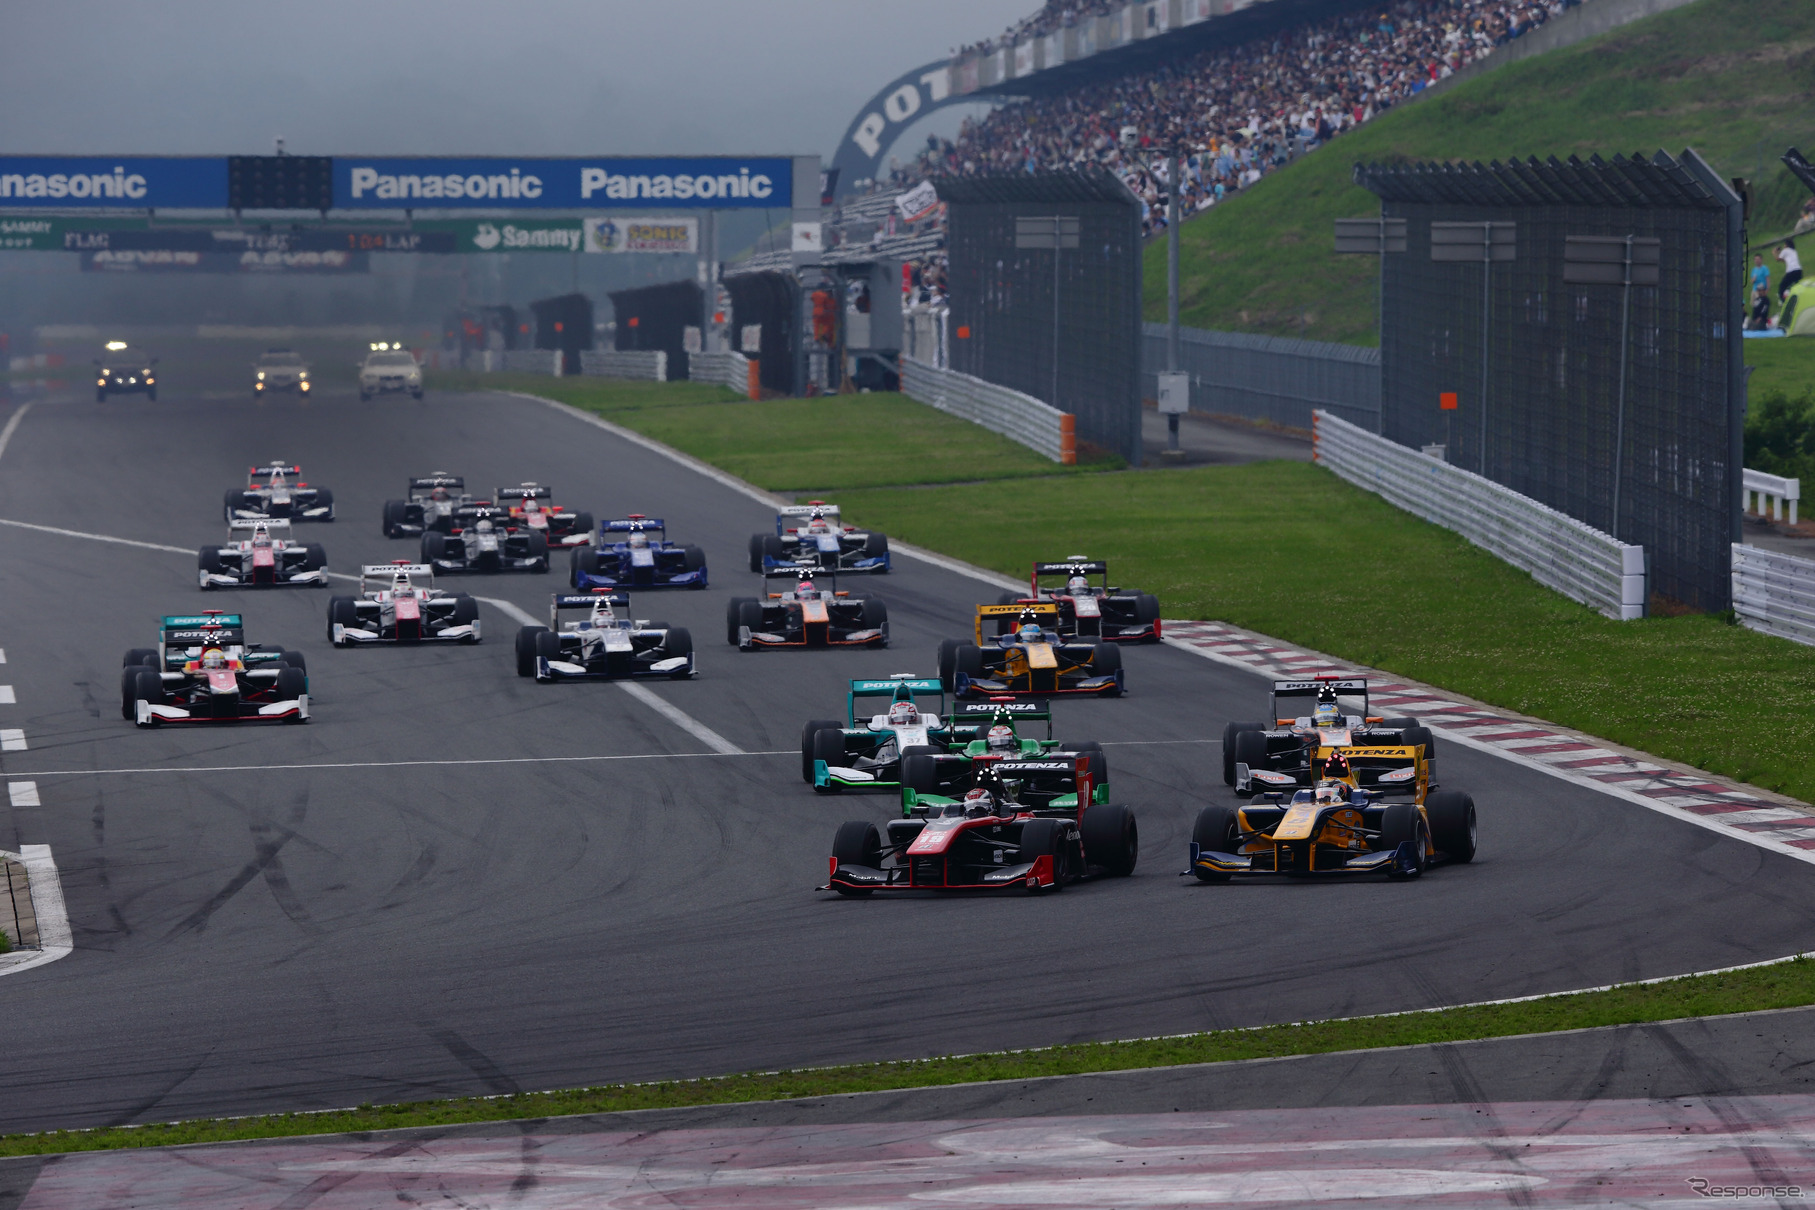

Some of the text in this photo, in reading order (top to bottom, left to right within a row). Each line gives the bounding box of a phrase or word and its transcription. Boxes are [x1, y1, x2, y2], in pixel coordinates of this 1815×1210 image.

[0, 166, 147, 199] nasonic
[351, 167, 543, 200] Panasonic
[580, 167, 773, 200] Panasonic
[502, 224, 582, 252] Sammy
[628, 224, 689, 241] SONIC
[919, 835, 945, 843] 19
